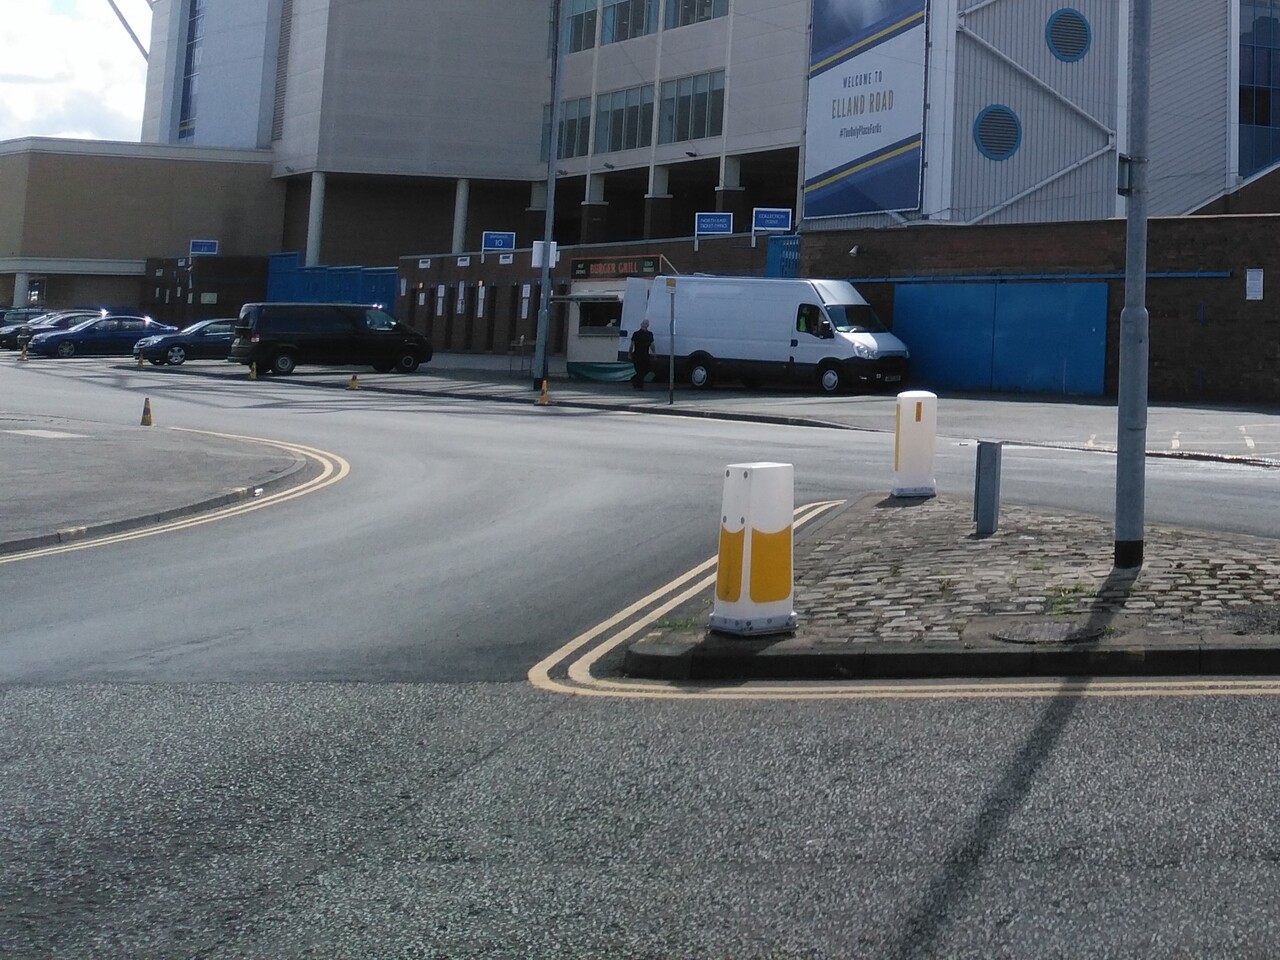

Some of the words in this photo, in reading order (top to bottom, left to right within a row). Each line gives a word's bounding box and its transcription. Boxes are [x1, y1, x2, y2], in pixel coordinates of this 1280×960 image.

[843, 72, 872, 88] WELCOME
[875, 70, 883, 83] TO
[831, 94, 865, 119] ELLAND
[869, 89, 894, 113] ROAD
[494, 239, 504, 247] 10
[589, 262, 616, 274] BURGER
[618, 261, 638, 273] GRILL
